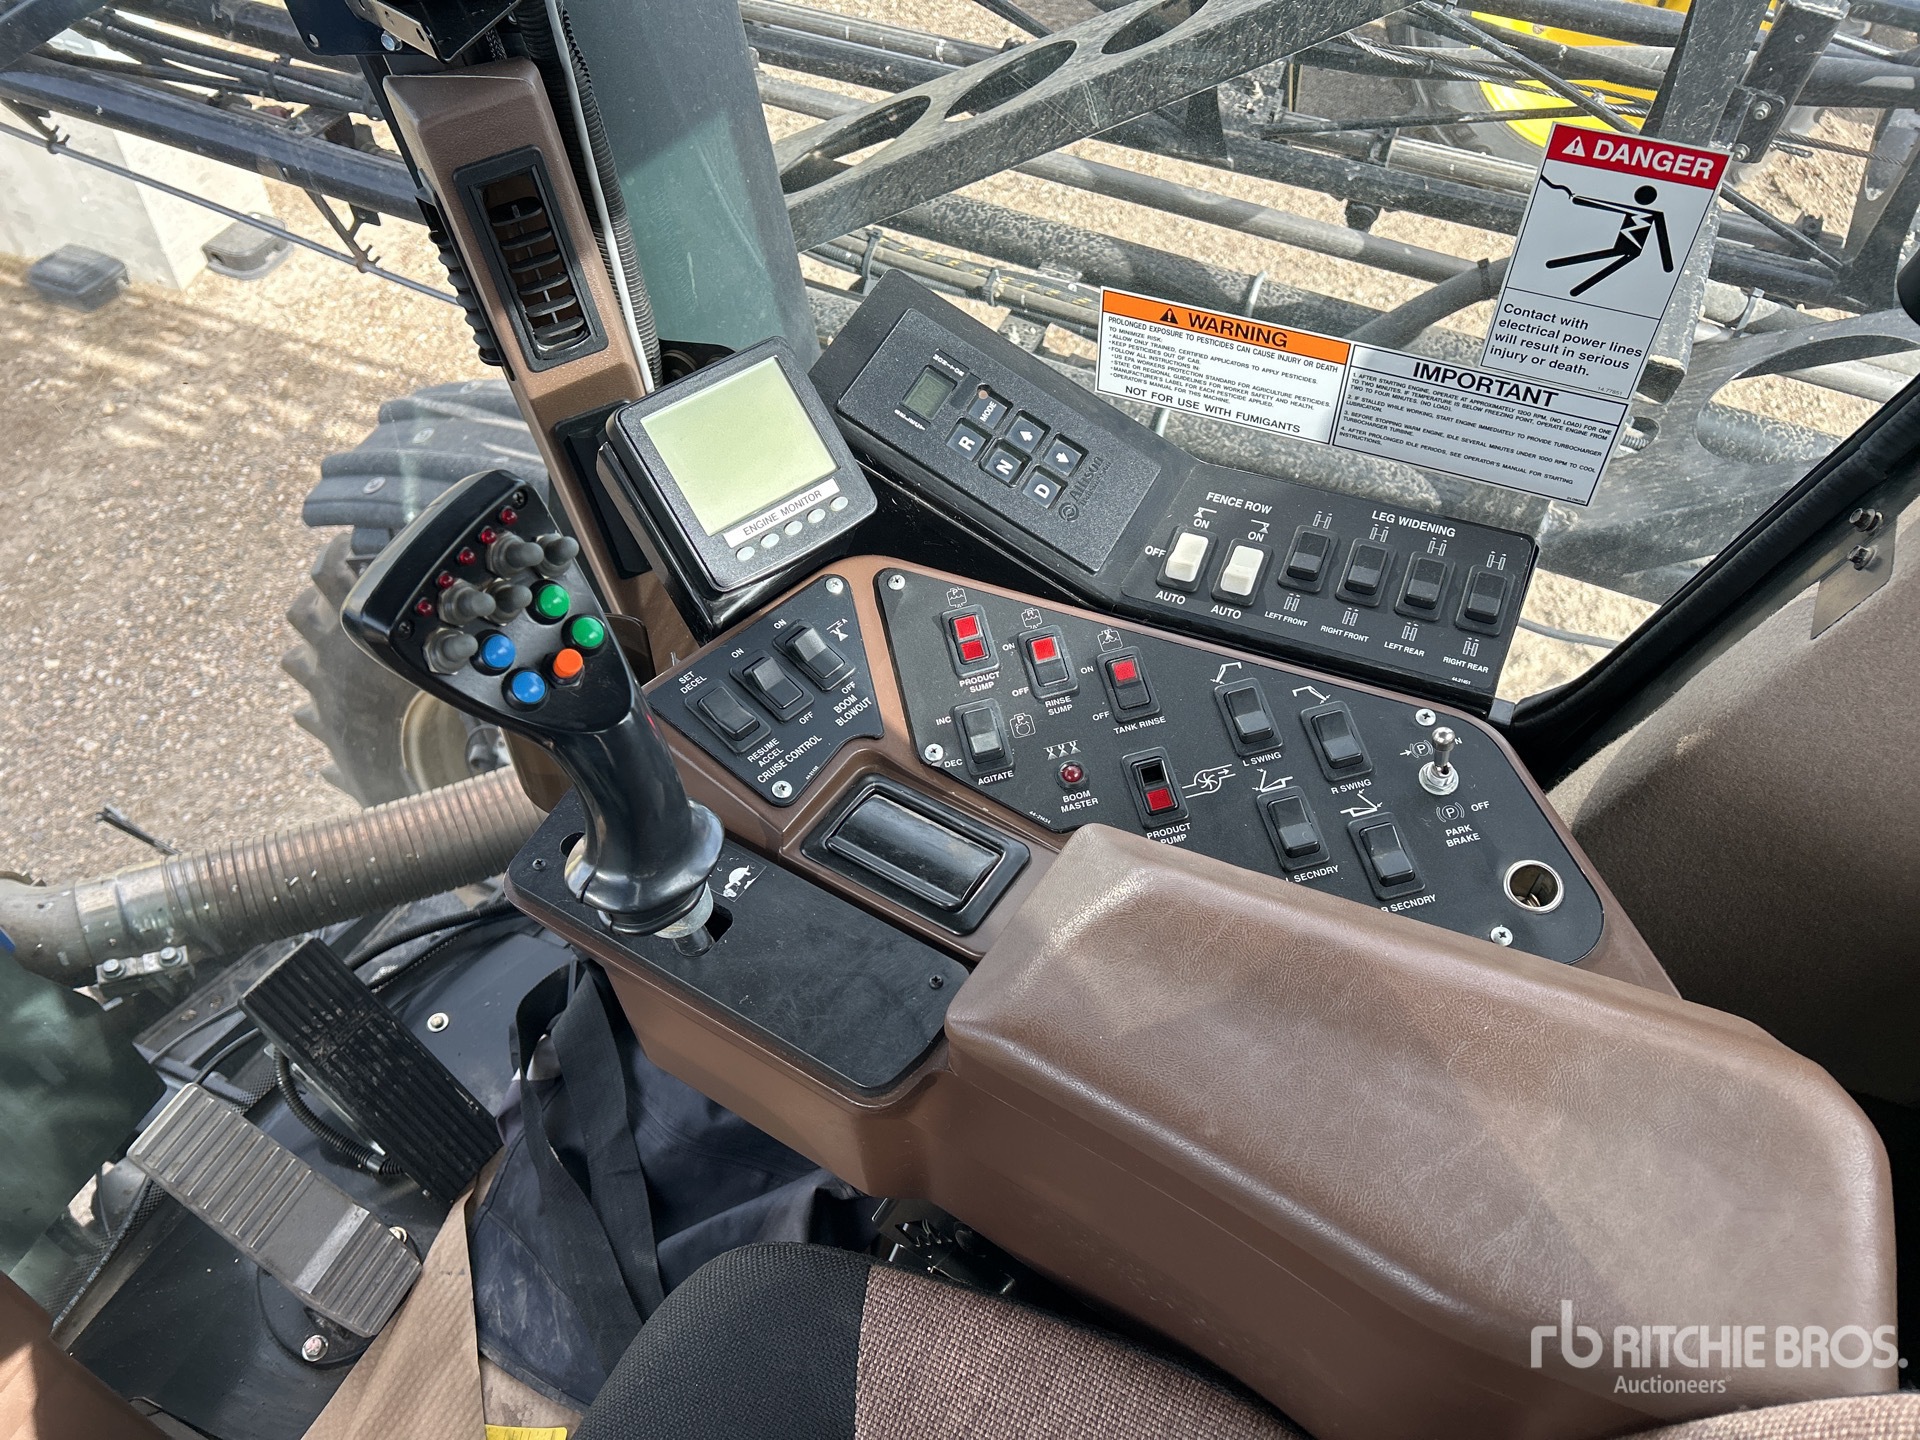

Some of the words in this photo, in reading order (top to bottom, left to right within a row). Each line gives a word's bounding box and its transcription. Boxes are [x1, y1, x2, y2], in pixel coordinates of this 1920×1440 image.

[1592, 139, 1714, 180] DANGER
[1503, 303, 1557, 324] Contact
[1560, 317, 1589, 330] with
[1109, 325, 1118, 333] TO
[1118, 328, 1145, 339] MINIMIZE
[1146, 334, 1162, 343] RISK:
[1188, 312, 1288, 348] WARNING
[1498, 318, 1561, 339] electrical
[1562, 333, 1607, 349] power
[1608, 341, 1643, 357] lines
[1108, 315, 1147, 331] PROLONGED
[1148, 325, 1184, 339] EXPOSURE
[1185, 333, 1195, 342] TO
[1196, 335, 1235, 350] PESTICIDES
[1236, 344, 1251, 354] CAN
[1252, 348, 1276, 360] CAUSE
[1277, 353, 1302, 365] INJURY
[1303, 359, 1314, 368] OR
[1315, 362, 1339, 373] DEATH
[1111, 339, 1127, 348] KEEP
[1127, 343, 1162, 356] PESTICIDES
[1162, 351, 1176, 359] OUT
[1187, 357, 1201, 365] CAB.
[1495, 333, 1518, 345] will
[1520, 339, 1559, 355] result
[1561, 346, 1575, 358] in
[1578, 352, 1630, 370] serious
[1110, 346, 1135, 356] FOLLOW
[1136, 352, 1147, 360] ALL
[1148, 355, 1191, 369] INSTRUCTIONS
[1112, 333, 1133, 343] ALLOW
[1133, 338, 1149, 346] ONLY
[1150, 341, 1177, 353] TRAINED,
[1178, 348, 1209, 360] CERTIFIED
[1209, 355, 1250, 369] APPLICATORS
[1251, 364, 1260, 372] TO
[1261, 367, 1280, 376] APPLY
[1280, 371, 1317, 384] PESTICIDES.
[1490, 344, 1528, 364] injury
[1531, 356, 1546, 366] or
[1548, 359, 1589, 376] death.
[1112, 372, 1148, 385] OPERATOR'S
[1149, 380, 1173, 391] MANUAL
[1173, 386, 1187, 394] FOR
[1188, 389, 1202, 398] THIS
[1202, 393, 1231, 404] MACHINE.
[1113, 366, 1164, 383] MANUFACTURER'S
[1164, 377, 1184, 387] LABEL
[1184, 382, 1198, 390] FOR
[1198, 385, 1216, 394] EACH
[1216, 390, 1247, 402] PESTICIDE
[1248, 397, 1274, 408] APPLIED.
[1123, 355, 1136, 363] EPA
[1136, 358, 1166, 370] WORKERS
[1167, 365, 1204, 379] PROTECTION
[1205, 374, 1237, 386] STANDARD
[1237, 381, 1251, 389] FOR
[1251, 385, 1293, 399] AGRICULTURE
[1294, 394, 1331, 408] PESTICIDES.
[1412, 361, 1560, 407] IMPORTANT
[979, 401, 997, 422] MODE
[1125, 385, 1148, 397] NOT
[1151, 391, 1174, 404] FOR
[1177, 397, 1200, 410] USE
[1204, 403, 1232, 418] WITH
[1235, 411, 1301, 433] FUMIGANTS
[959, 436, 975, 451] R
[996, 459, 1013, 475] N
[1070, 456, 1104, 502] Allison
[1034, 484, 1050, 499] D
[1206, 492, 1244, 508] FENCE
[1244, 500, 1273, 514] ROW
[742, 512, 779, 536] ENGINE
[780, 490, 822, 516] MONITOR
[1193, 518, 1210, 529] ON
[1371, 510, 1395, 523] LEG
[1399, 516, 1456, 537] WIDENING
[1248, 531, 1264, 542] ON
[1144, 545, 1166, 557] OFF
[1155, 590, 1186, 605] AUTO
[1210, 605, 1241, 619] AUTO
[1264, 611, 1283, 620] LEFT
[1283, 615, 1308, 627] FRONT
[773, 619, 787, 629] ON
[1320, 625, 1344, 636] RIGHT
[1343, 631, 1369, 642] FRONT
[731, 648, 744, 658] ON
[1002, 643, 1015, 651] ON
[1384, 641, 1404, 651] LEFT
[1403, 646, 1425, 657] REAR
[1080, 666, 1094, 674] ON
[1443, 656, 1467, 667] RIGHT
[1467, 662, 1489, 673] REAR
[678, 671, 694, 684] SET
[680, 676, 707, 694] DECEL
[959, 671, 1000, 687] PRODUCT
[841, 681, 855, 694] OFF
[969, 681, 994, 693] SUMP
[1012, 686, 1029, 697] OFF
[833, 694, 858, 714] BOOM
[1045, 695, 1072, 708] RINSE
[799, 711, 813, 724] OFF
[835, 697, 872, 726] BLOWOUT
[1048, 704, 1073, 716] SUMP
[1092, 711, 1109, 721] OFF
[936, 716, 952, 726] INC
[1113, 723, 1138, 734] TANK
[1139, 716, 1166, 728] RINSE
[747, 738, 780, 763] RESUME
[758, 748, 784, 767] ACCEL
[1250, 751, 1282, 765] SWING
[757, 759, 788, 783] CRUISE
[785, 736, 822, 763] CONTROL
[944, 758, 963, 768] DEC
[978, 770, 1014, 785] AGITATE
[1331, 787, 1339, 795] R
[1340, 779, 1372, 792] SWING
[1062, 790, 1091, 803] BOOM
[1061, 797, 1099, 813] MASTER
[1471, 801, 1489, 812] OFF
[1146, 822, 1191, 842] PRODUCT
[1445, 824, 1472, 837] PARK
[1446, 833, 1481, 847] BRAKE
[1294, 865, 1338, 886] SECNDRY
[1390, 894, 1436, 915] SECNDRY
